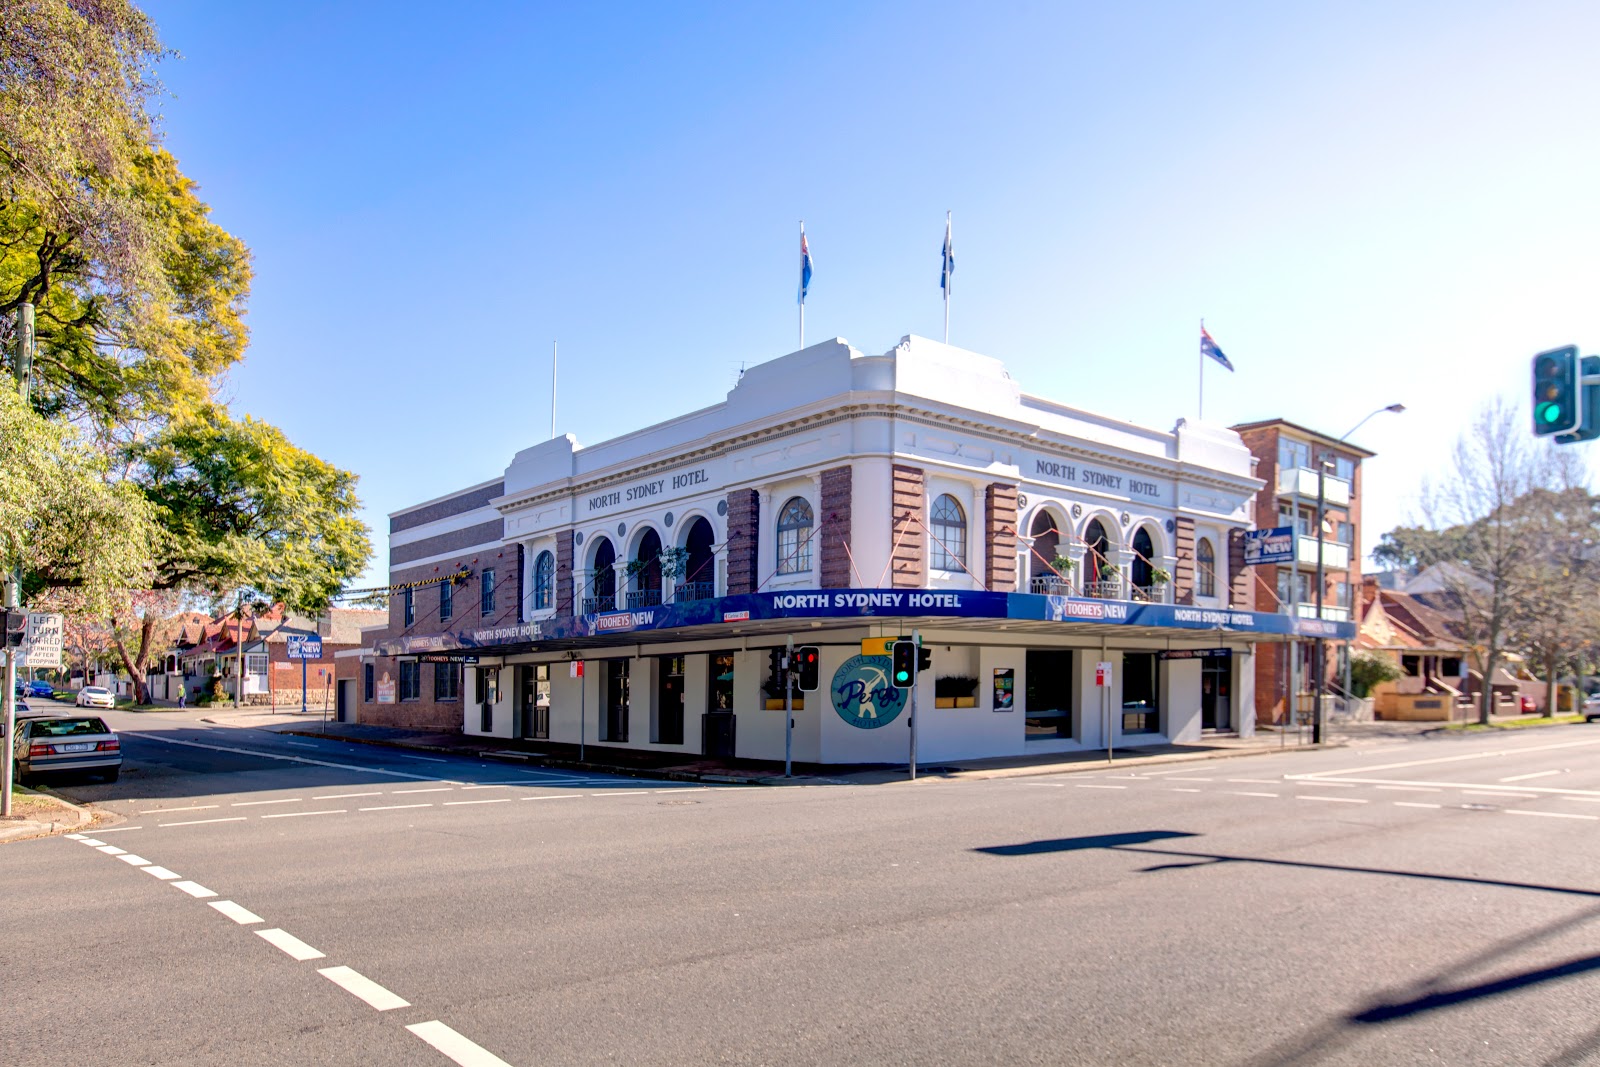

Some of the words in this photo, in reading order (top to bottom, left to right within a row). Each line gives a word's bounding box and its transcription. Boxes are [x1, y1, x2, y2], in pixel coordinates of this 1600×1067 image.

[1036, 460, 1075, 480] NORTH
[1082, 470, 1122, 489] SYDNEY
[1129, 479, 1160, 497] HOTEL
[589, 492, 620, 511] NORTH
[626, 480, 664, 501] SYDNEY
[672, 469, 709, 490] HOTEL
[1263, 542, 1291, 554] NEW
[773, 595, 830, 609] NORTH
[834, 594, 903, 607] SYDNEY
[908, 594, 962, 608] HOTEL
[1067, 603, 1102, 616] TOOHEYS
[1104, 605, 1127, 619] NEW
[1174, 609, 1200, 622] NORTH
[1202, 611, 1230, 624] SYDNEY
[1231, 614, 1254, 626] HOTEL
[33, 616, 57, 624] LEFT
[600, 613, 631, 628] TOOHEYS
[631, 611, 654, 626] NEW
[33, 627, 59, 635] TURN
[473, 630, 493, 641] NORTH
[495, 627, 519, 640] SYDNEY
[521, 624, 542, 636] HOTEL
[30, 636, 41, 644] ON
[430, 636, 444, 647] NEW
[835, 655, 865, 682] NORTH
